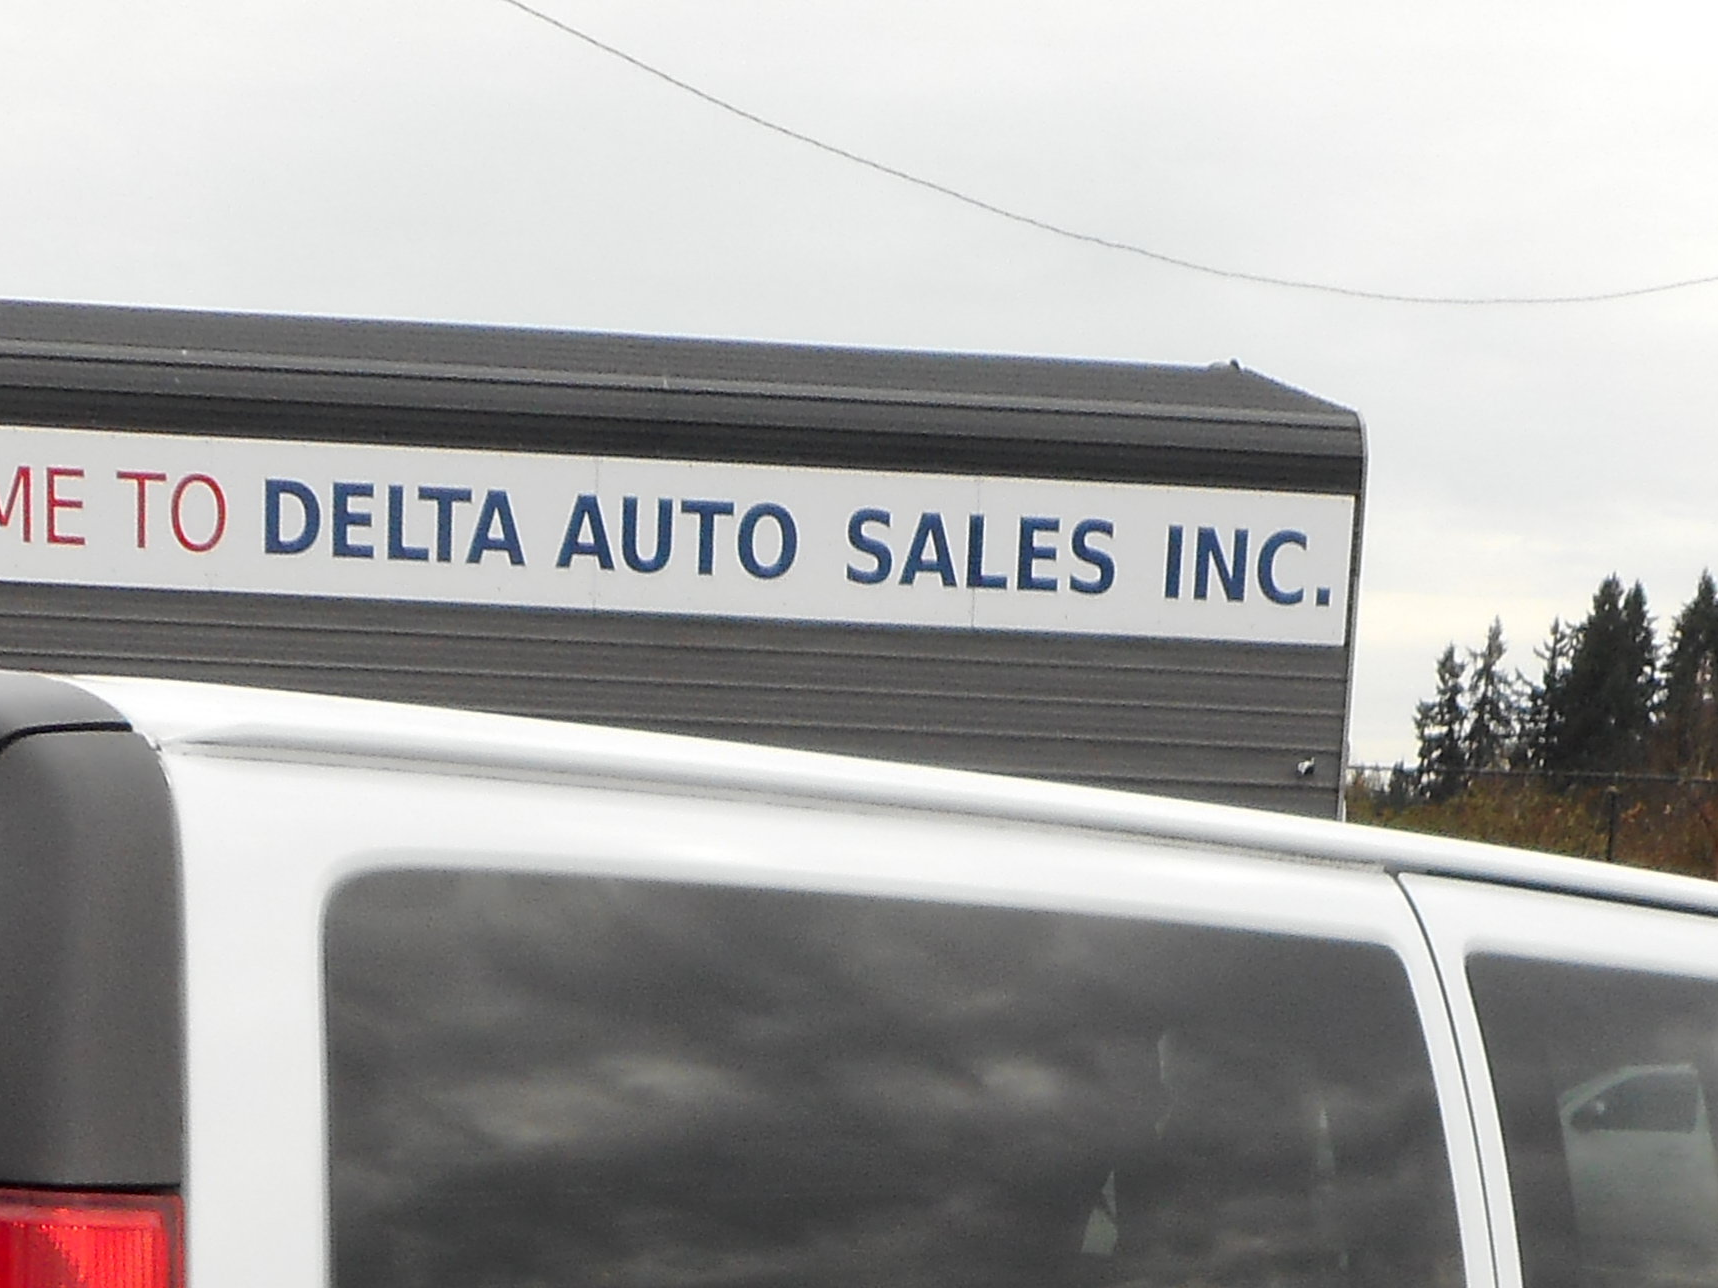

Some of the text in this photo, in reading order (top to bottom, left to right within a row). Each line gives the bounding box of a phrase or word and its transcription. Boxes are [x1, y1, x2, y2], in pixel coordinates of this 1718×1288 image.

[115, 470, 227, 554] TO
[263, 477, 526, 567] DELTA
[555, 492, 799, 582] AUTO
[844, 508, 1117, 596] SALES
[1163, 524, 1333, 608] INC.
